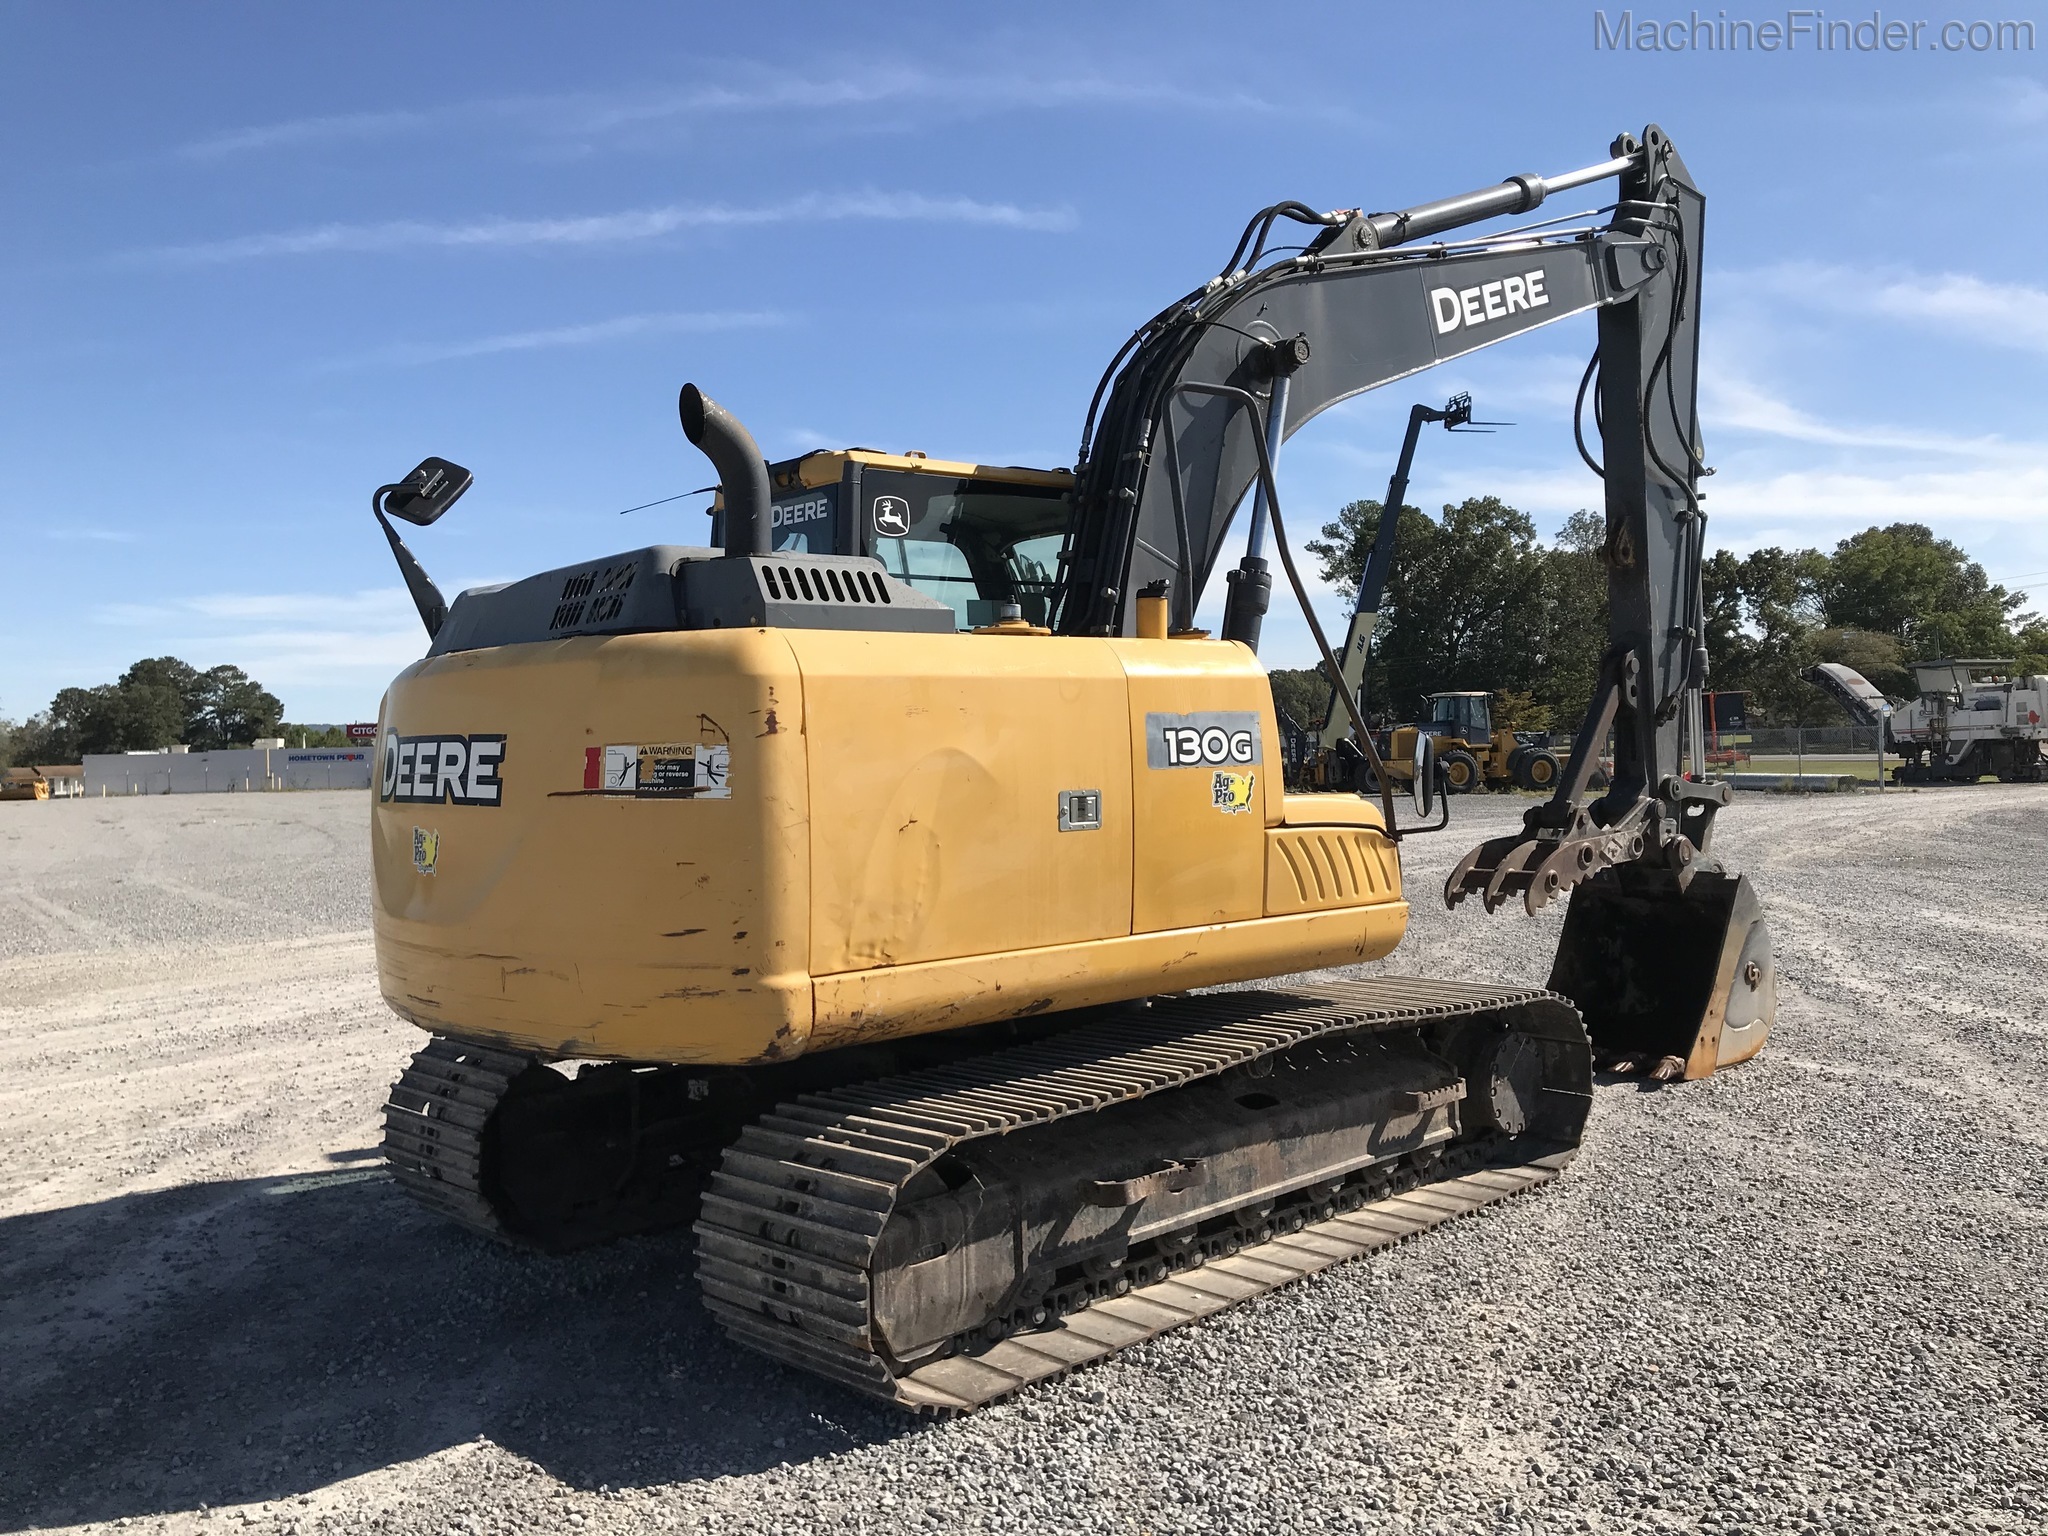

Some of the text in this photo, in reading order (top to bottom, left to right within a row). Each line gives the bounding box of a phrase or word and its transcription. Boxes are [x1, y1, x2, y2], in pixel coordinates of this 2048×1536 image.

[1430, 269, 1549, 335] DEERE
[771, 498, 828, 529] DEERE
[1356, 633, 1366, 654] JLG
[649, 746, 692, 755] WARNING
[1163, 726, 1254, 767] 130G
[288, 753, 335, 761] HOMETOWN
[381, 732, 503, 801] DEERE
[1213, 773, 1234, 791] Ag-
[1214, 788, 1234, 803] Pro
[414, 845, 427, 862] Pro
